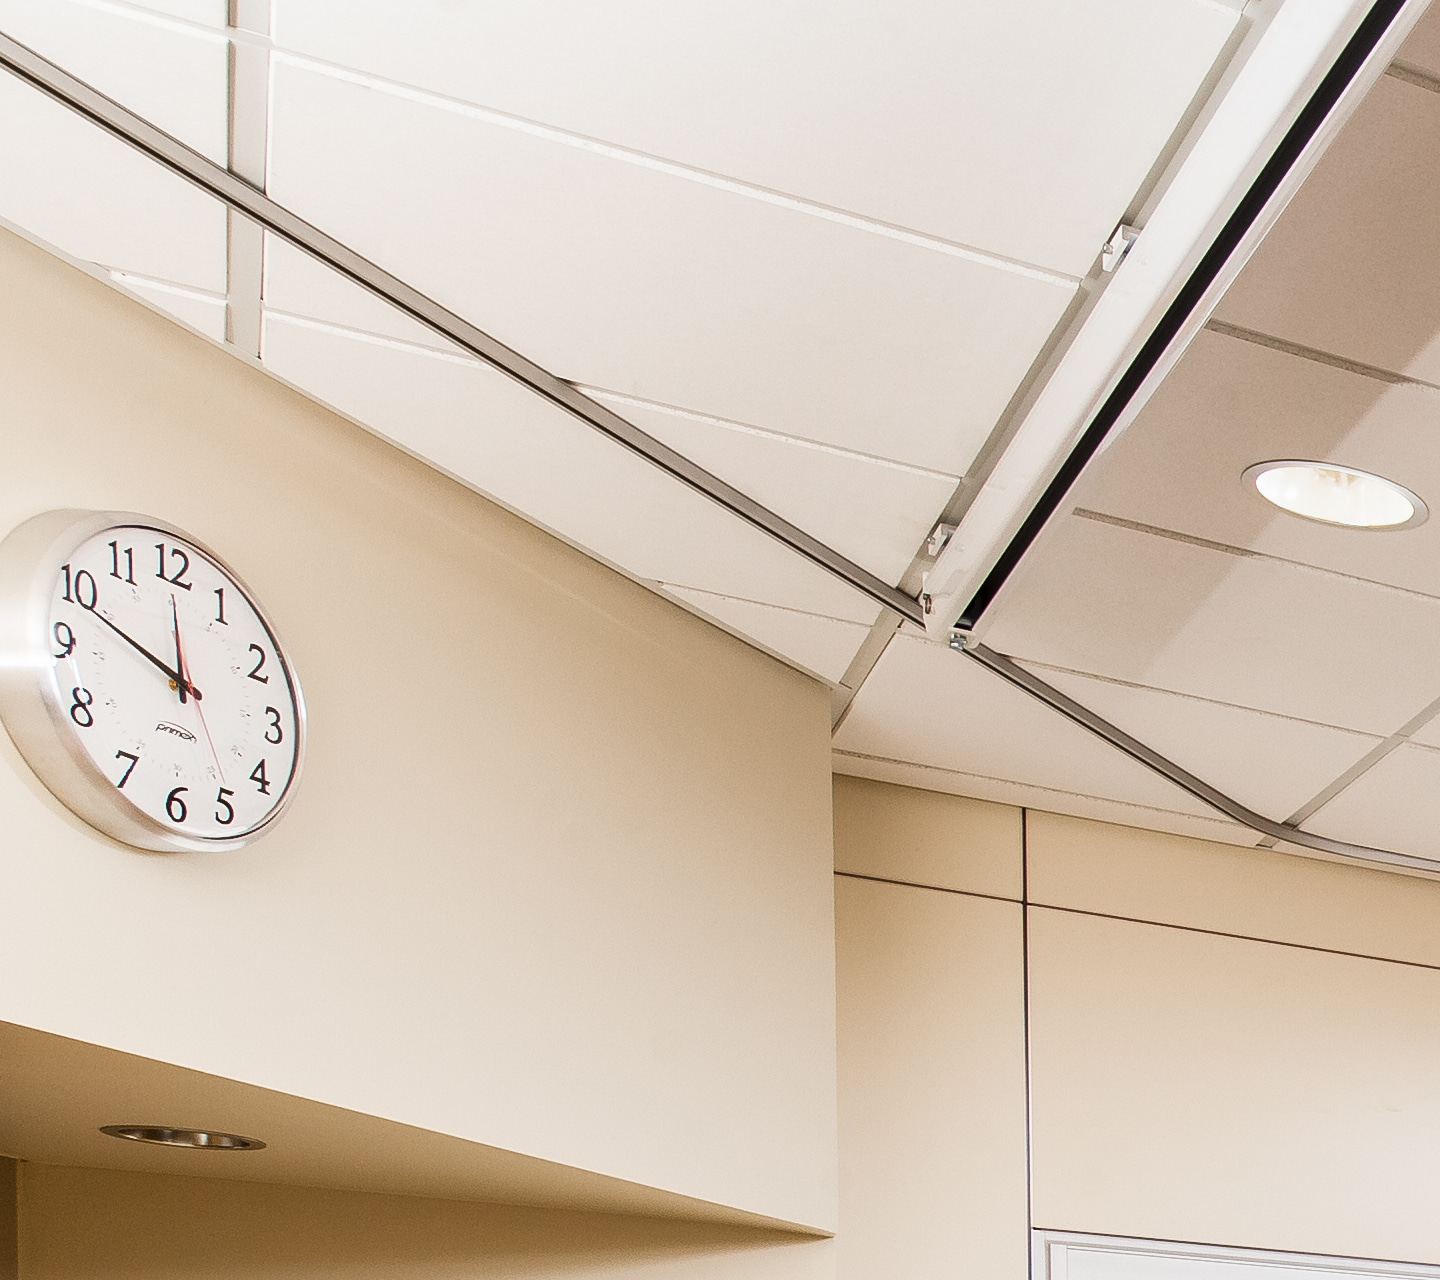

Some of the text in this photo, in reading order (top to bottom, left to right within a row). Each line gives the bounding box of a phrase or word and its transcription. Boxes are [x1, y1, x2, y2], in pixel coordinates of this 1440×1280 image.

[108, 541, 138, 586] 11
[155, 543, 193, 591] 12
[61, 564, 98, 610] 10
[214, 588, 229, 625] 1
[54, 622, 77, 658] 9
[247, 644, 269, 684] 2
[70, 687, 93, 727] 8
[264, 706, 283, 744] 3
[115, 750, 140, 788] 7
[249, 759, 271, 795] 4
[166, 787, 188, 823] 6
[215, 787, 235, 825] 5
